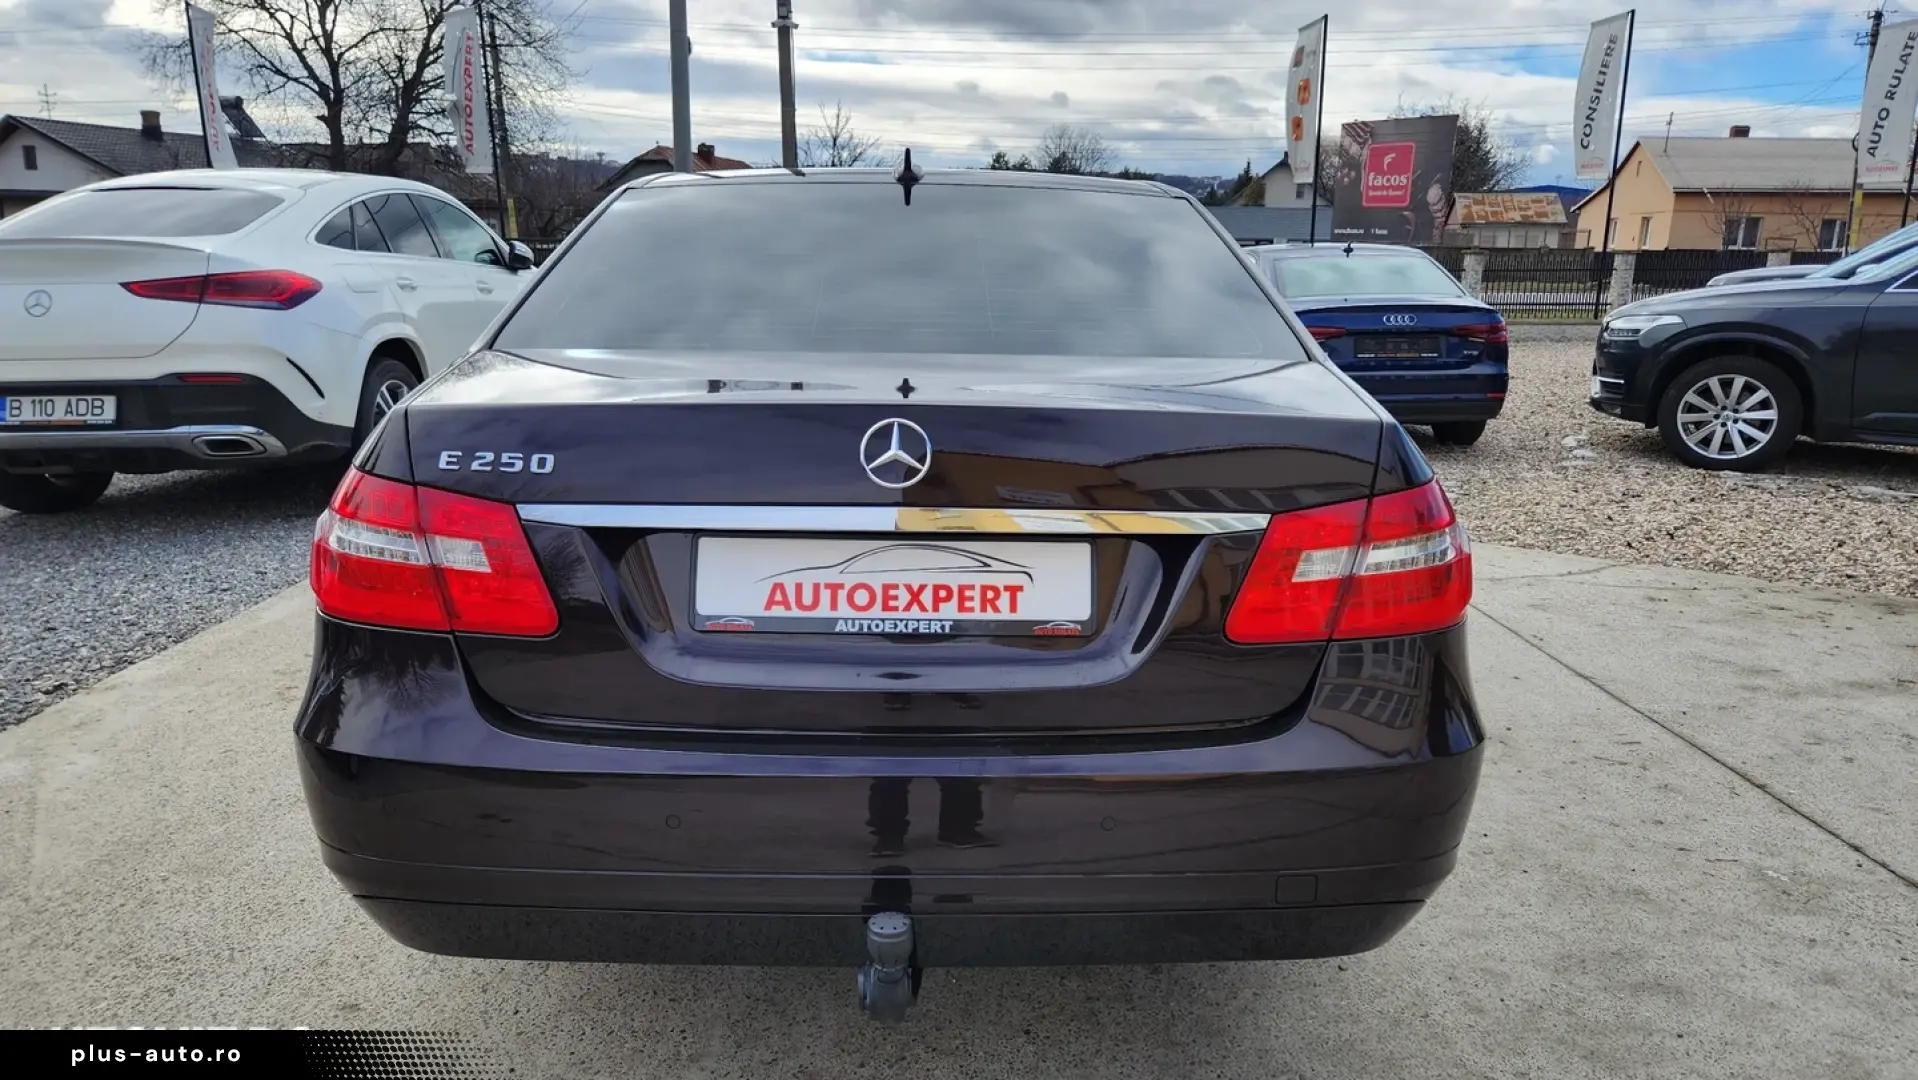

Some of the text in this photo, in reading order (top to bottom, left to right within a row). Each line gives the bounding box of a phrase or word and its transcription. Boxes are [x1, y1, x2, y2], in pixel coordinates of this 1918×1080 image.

[463, 31, 475, 157] AUTOEXPERT
[1580, 33, 1619, 150] CONSILIERE
[1867, 31, 1918, 158] AUTO RULATE
[1368, 172, 1407, 186] facos
[9, 397, 105, 418] B 110 ADB
[438, 450, 555, 474] E 250
[763, 581, 1024, 614] AUTOEXPERT
[834, 618, 954, 633] AUTOEXPERT
